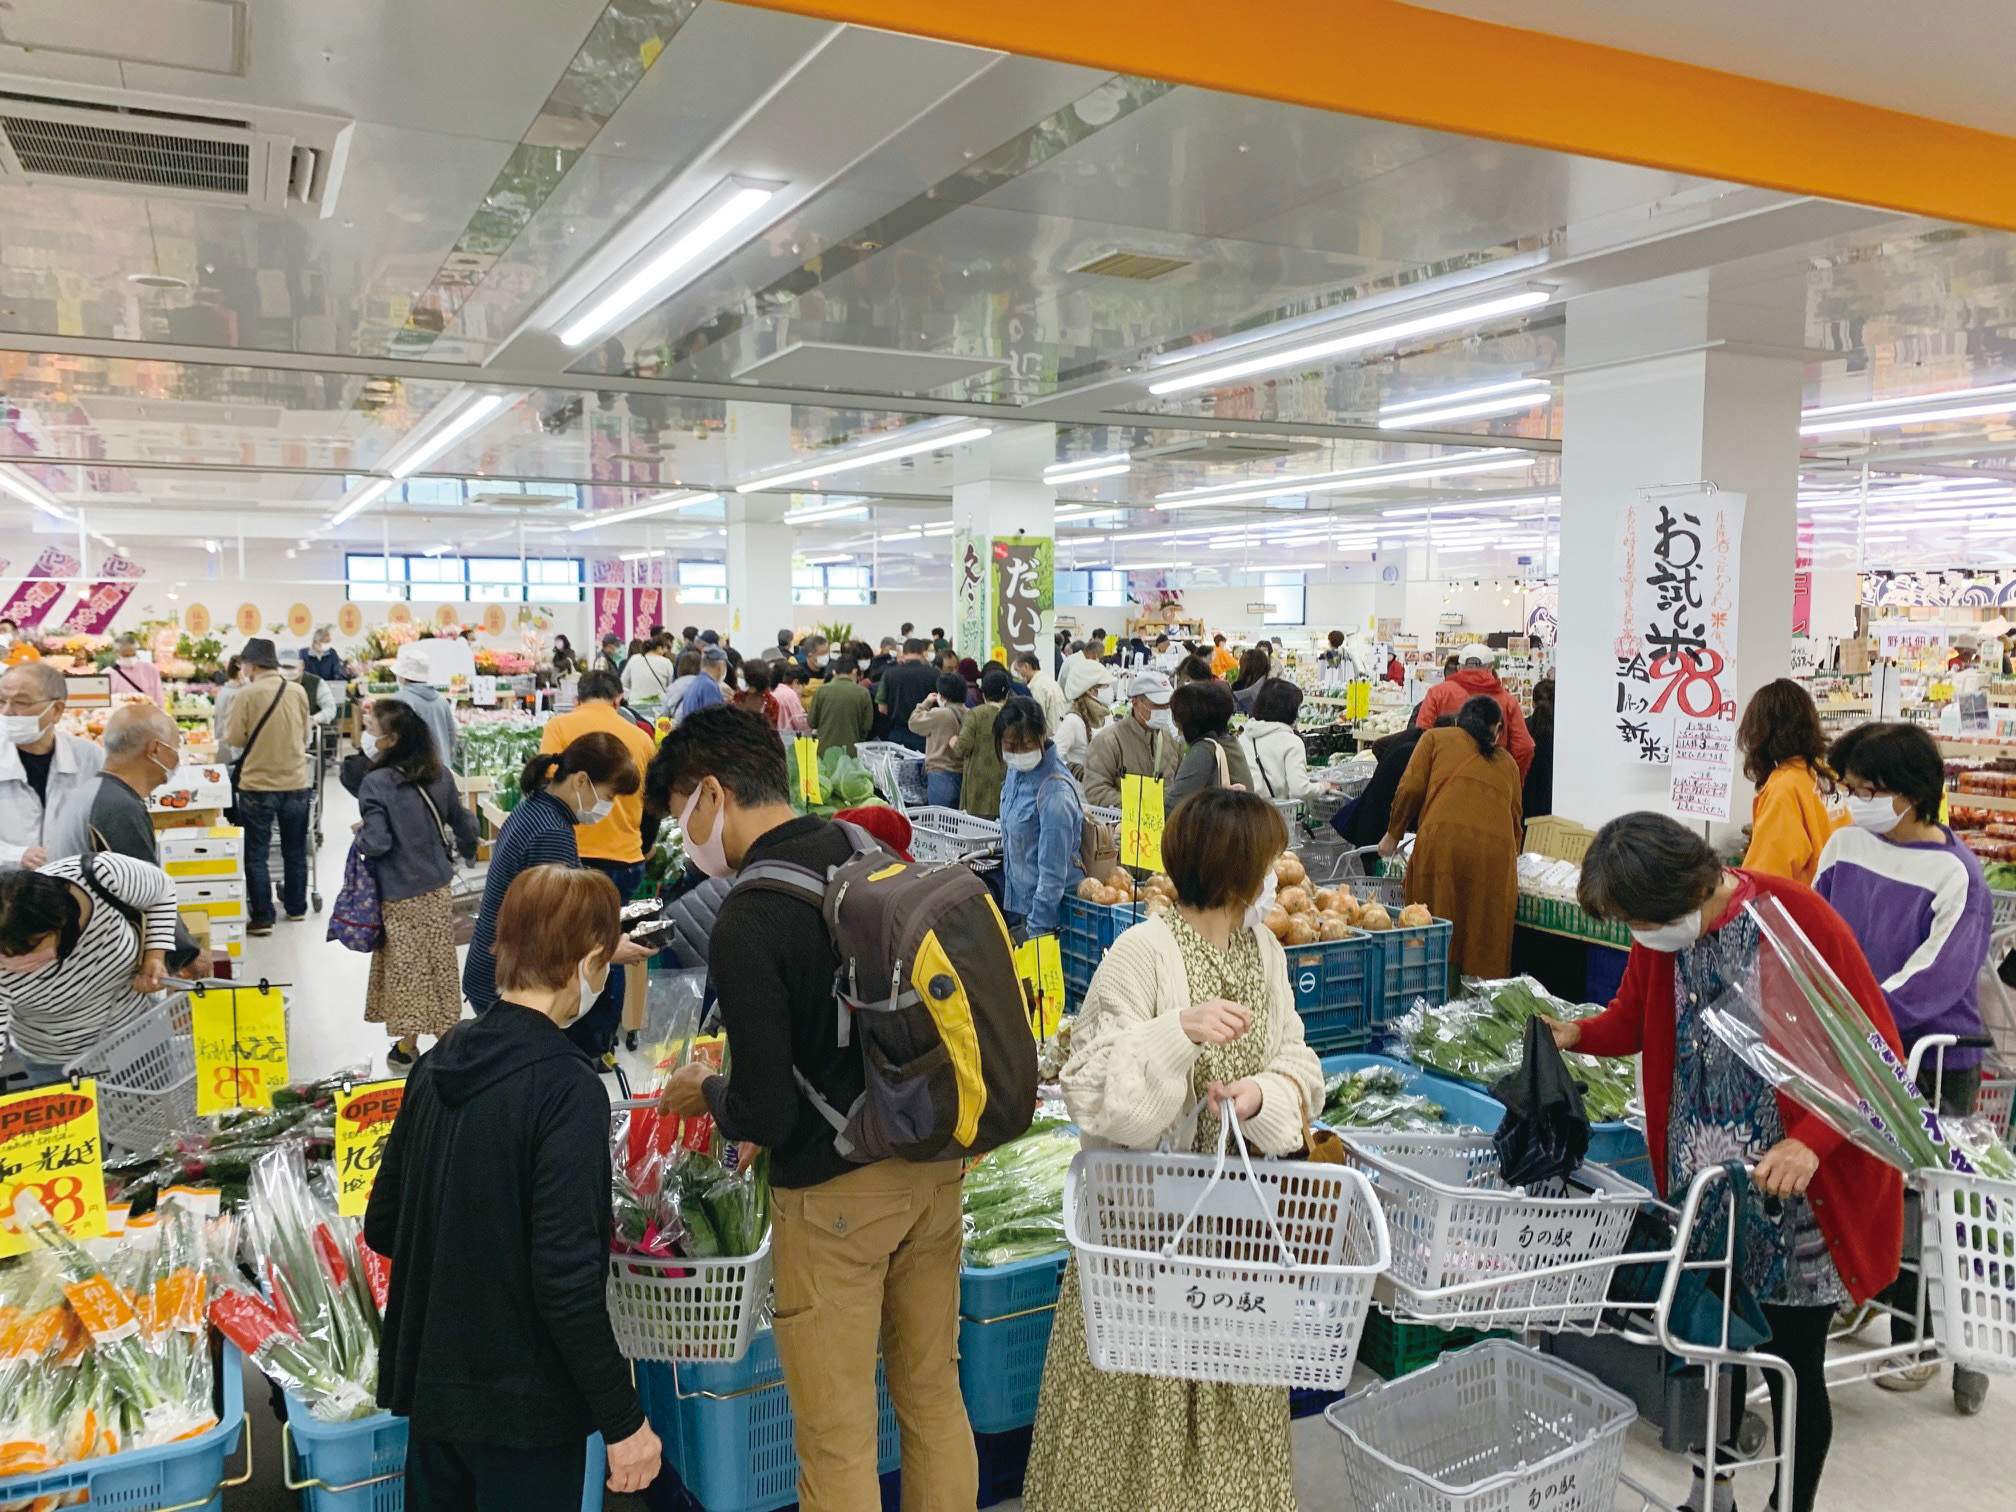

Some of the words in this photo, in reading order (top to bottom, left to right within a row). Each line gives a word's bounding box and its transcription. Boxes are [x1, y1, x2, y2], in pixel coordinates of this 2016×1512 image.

[1645, 505, 1707, 667] お試し米
[1649, 649, 1724, 718] 98
[1718, 700, 1737, 722] 円
[914, 837, 938, 853] 旬の駅
[1519, 1224, 1573, 1248] 旬の駅
[1186, 1285, 1267, 1314] 旬の駅
[1528, 1474, 1576, 1510] 旬の駅
